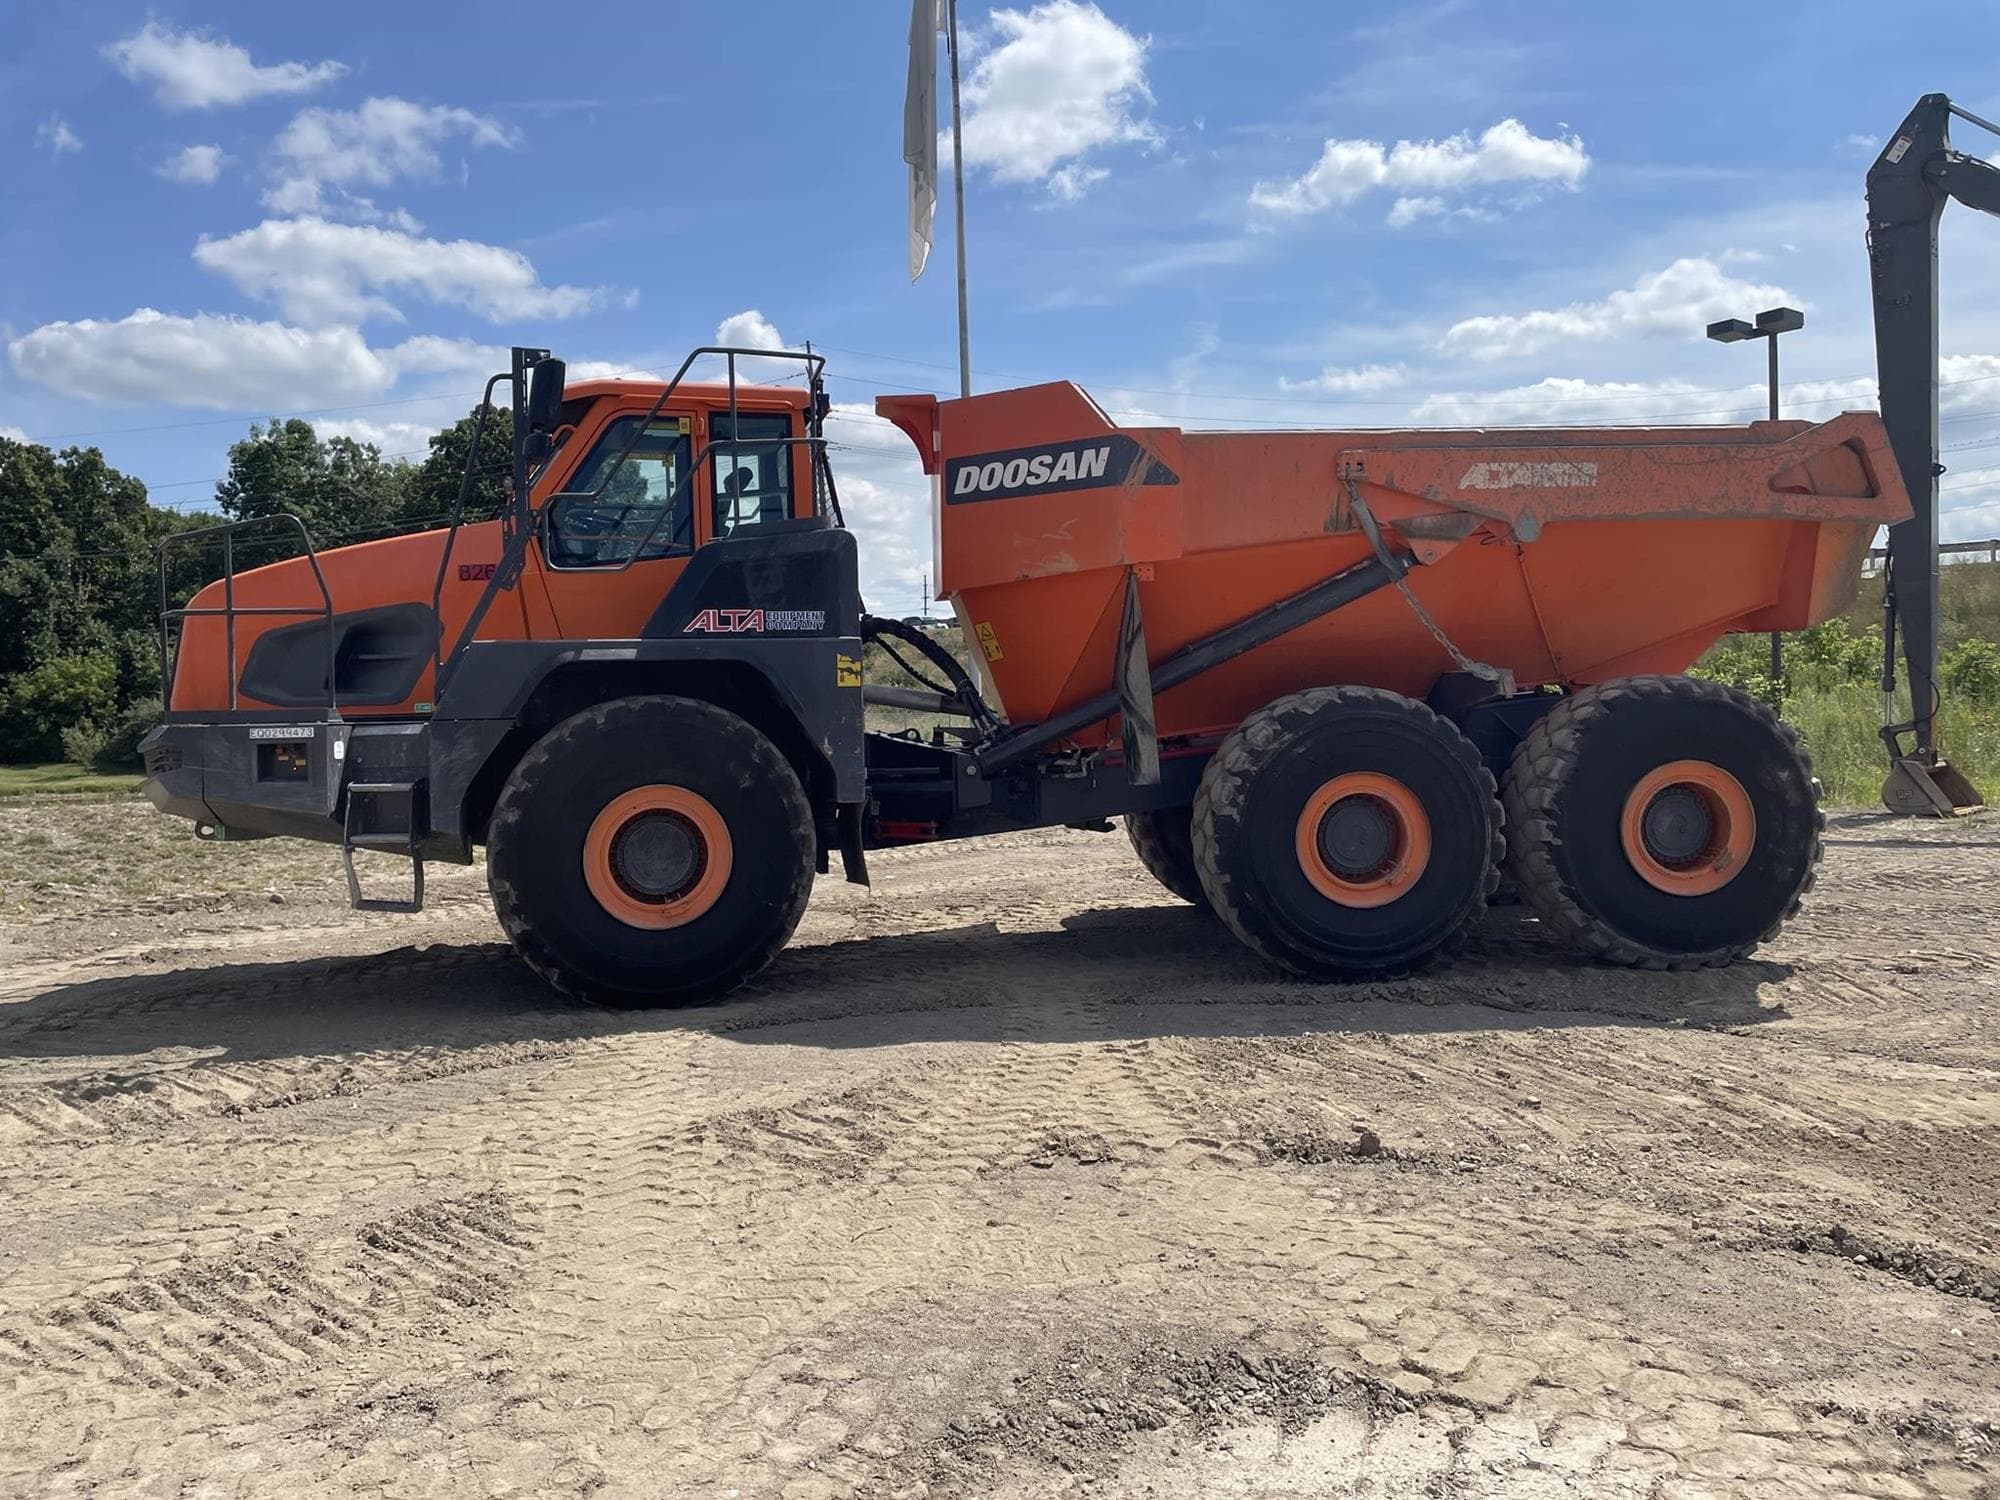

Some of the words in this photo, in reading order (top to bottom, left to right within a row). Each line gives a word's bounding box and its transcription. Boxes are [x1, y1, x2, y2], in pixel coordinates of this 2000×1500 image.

[954, 447, 1110, 494] DOOSAN
[683, 609, 765, 633] ALTA
[765, 610, 825, 621] EQUIPMENT
[765, 620, 825, 631] COMPANY
